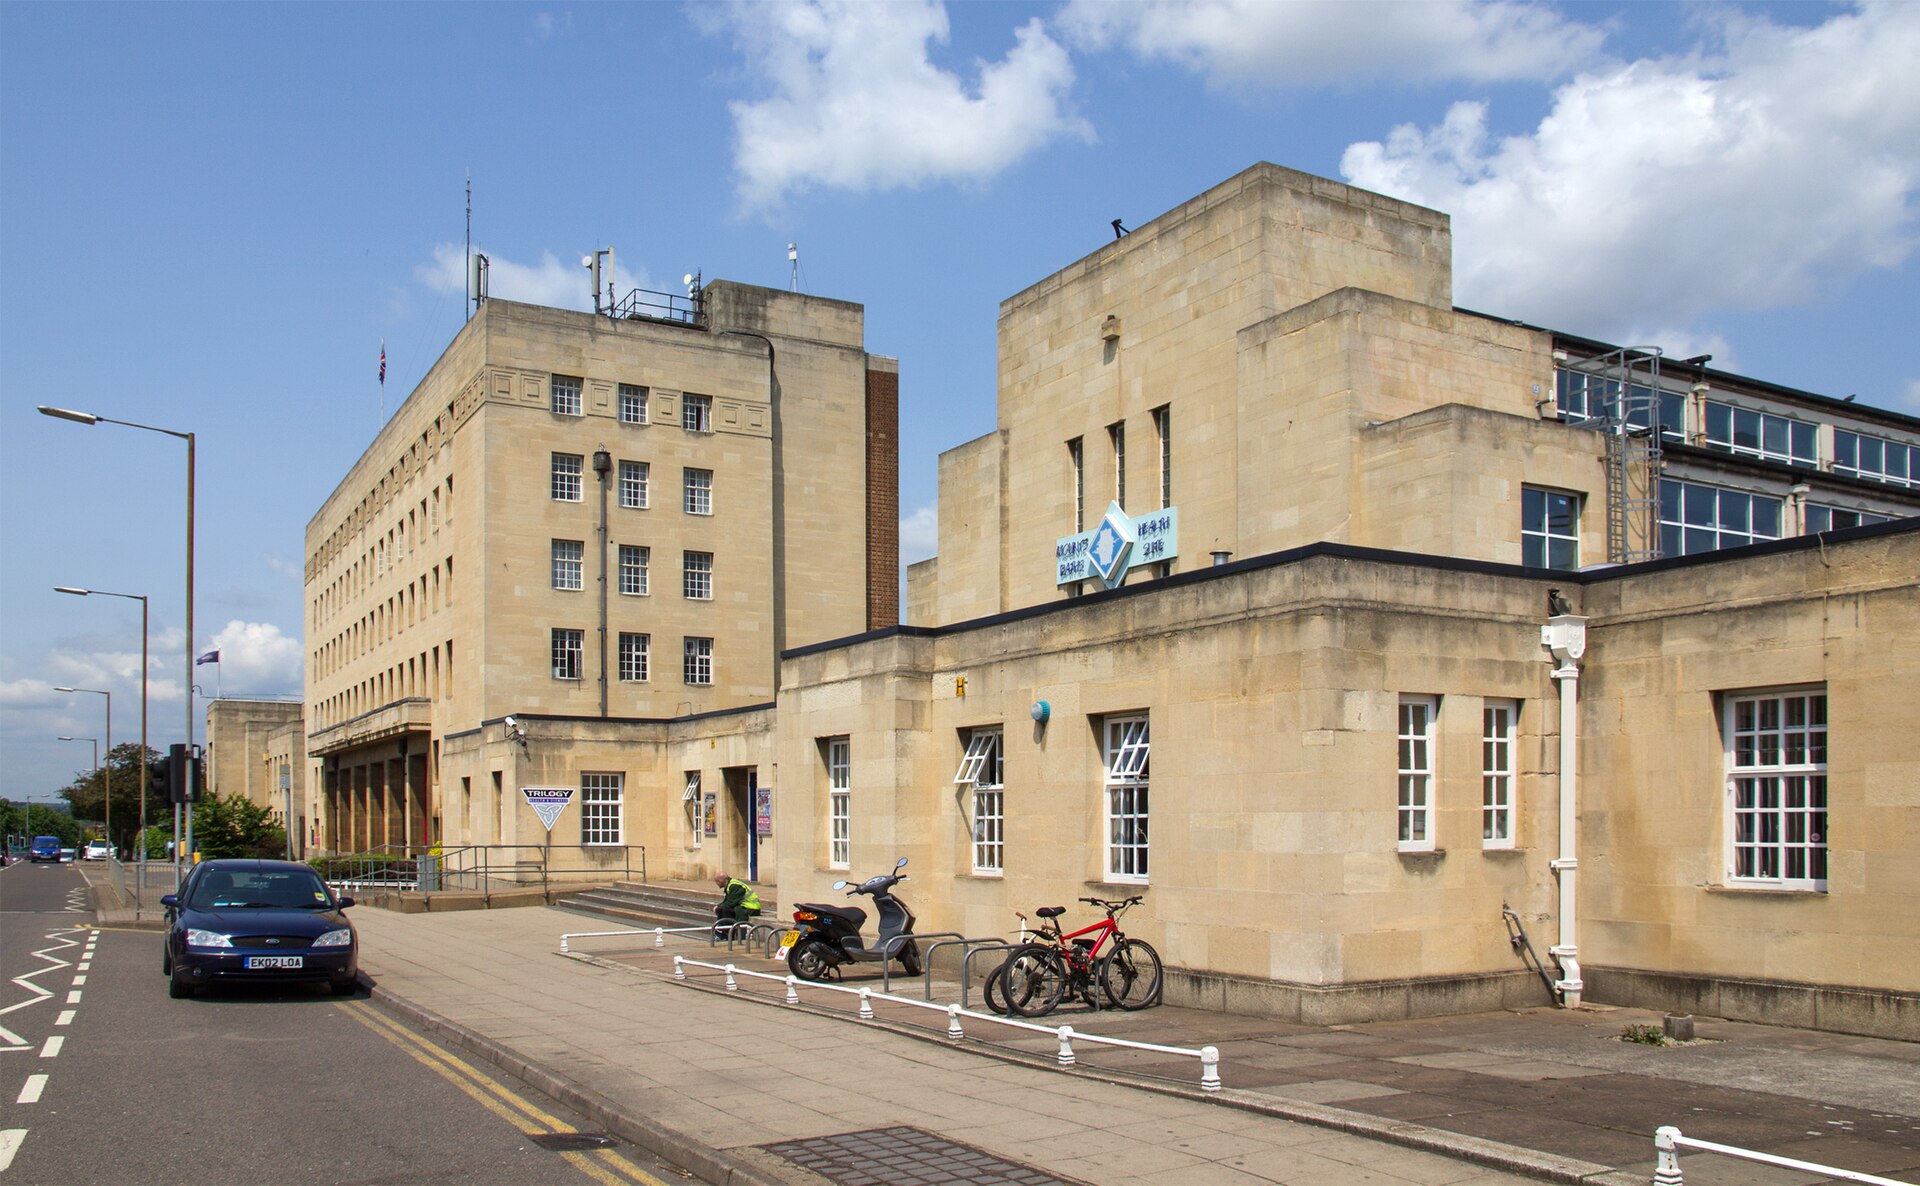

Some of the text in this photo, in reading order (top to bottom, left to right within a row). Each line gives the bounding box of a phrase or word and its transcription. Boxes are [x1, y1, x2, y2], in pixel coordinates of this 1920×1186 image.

[1137, 516, 1170, 537] HEALTH
[251, 958, 302, 968] EK02 LOA
